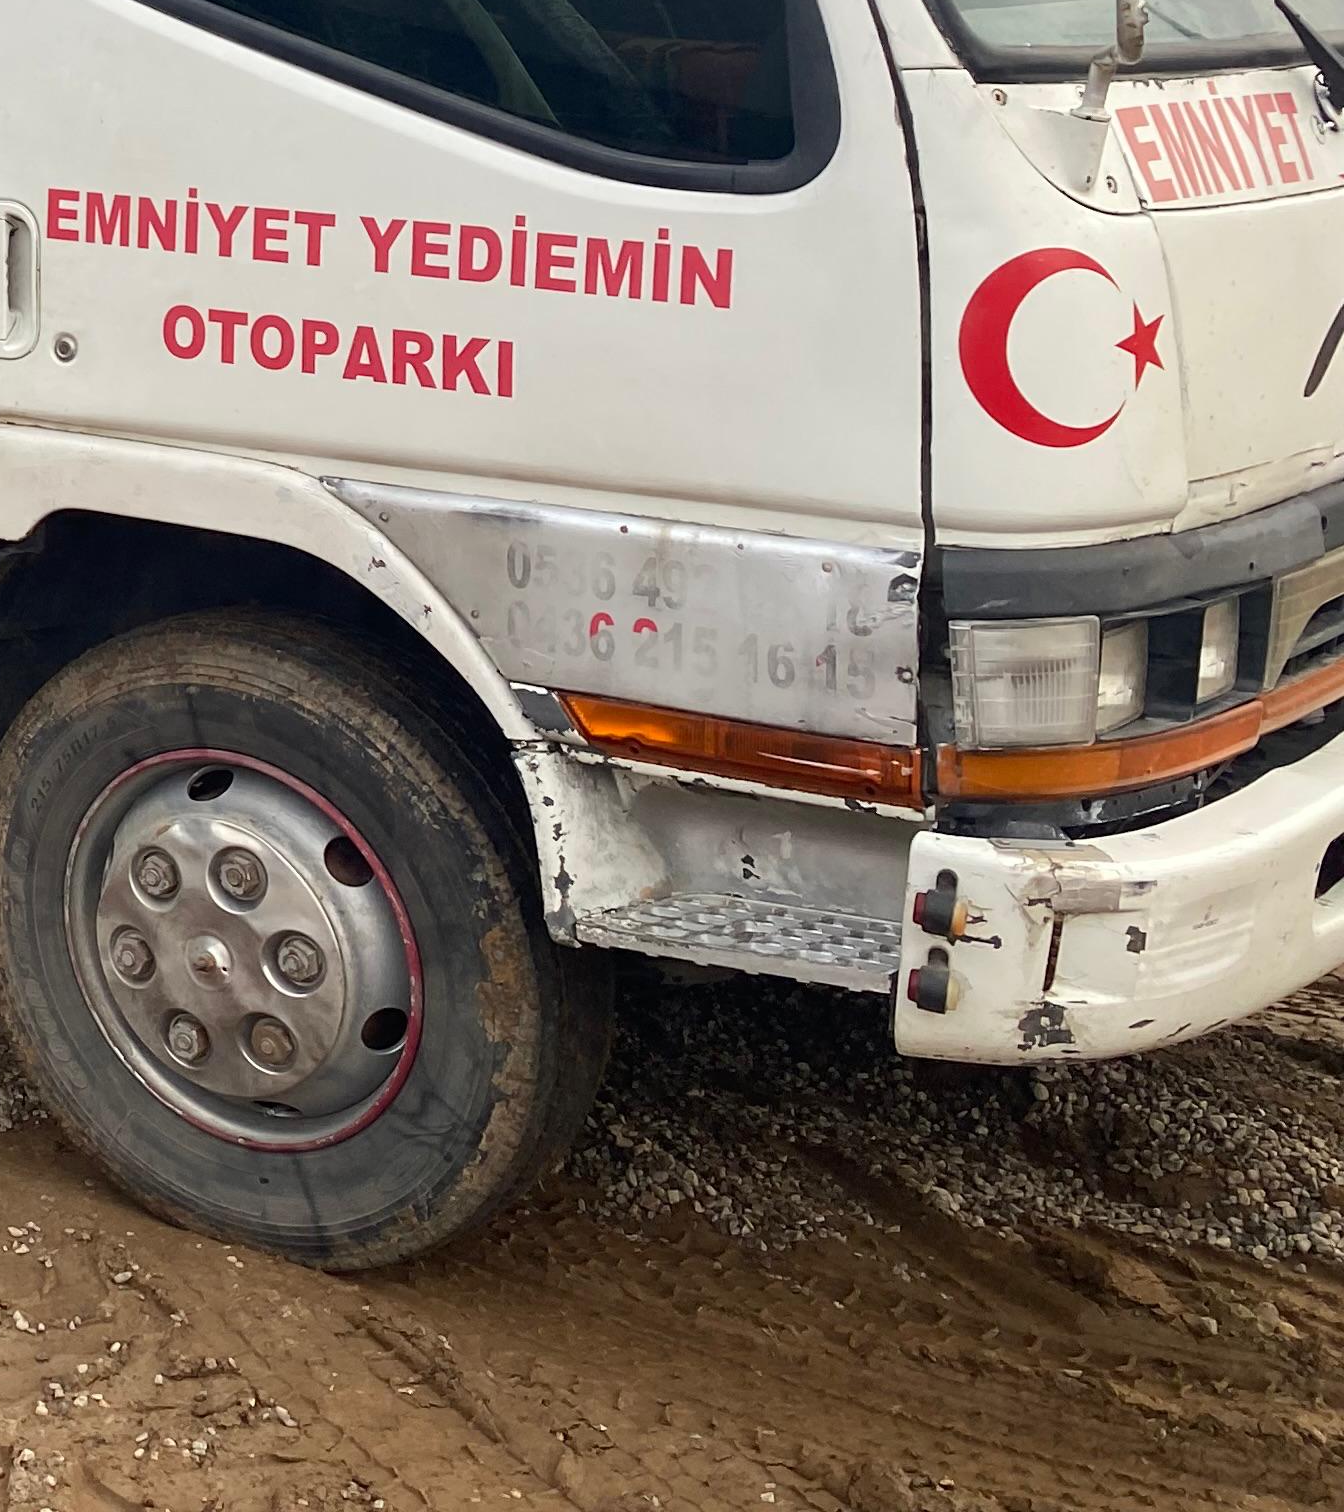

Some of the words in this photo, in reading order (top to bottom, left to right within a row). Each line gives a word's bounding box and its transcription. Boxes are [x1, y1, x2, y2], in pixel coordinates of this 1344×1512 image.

[1115, 78, 1315, 203] EMNİYET
[47, 187, 336, 268] EMNİYET
[359, 214, 733, 309] YEDİEMİN
[163, 304, 514, 398] OTOPARKI
